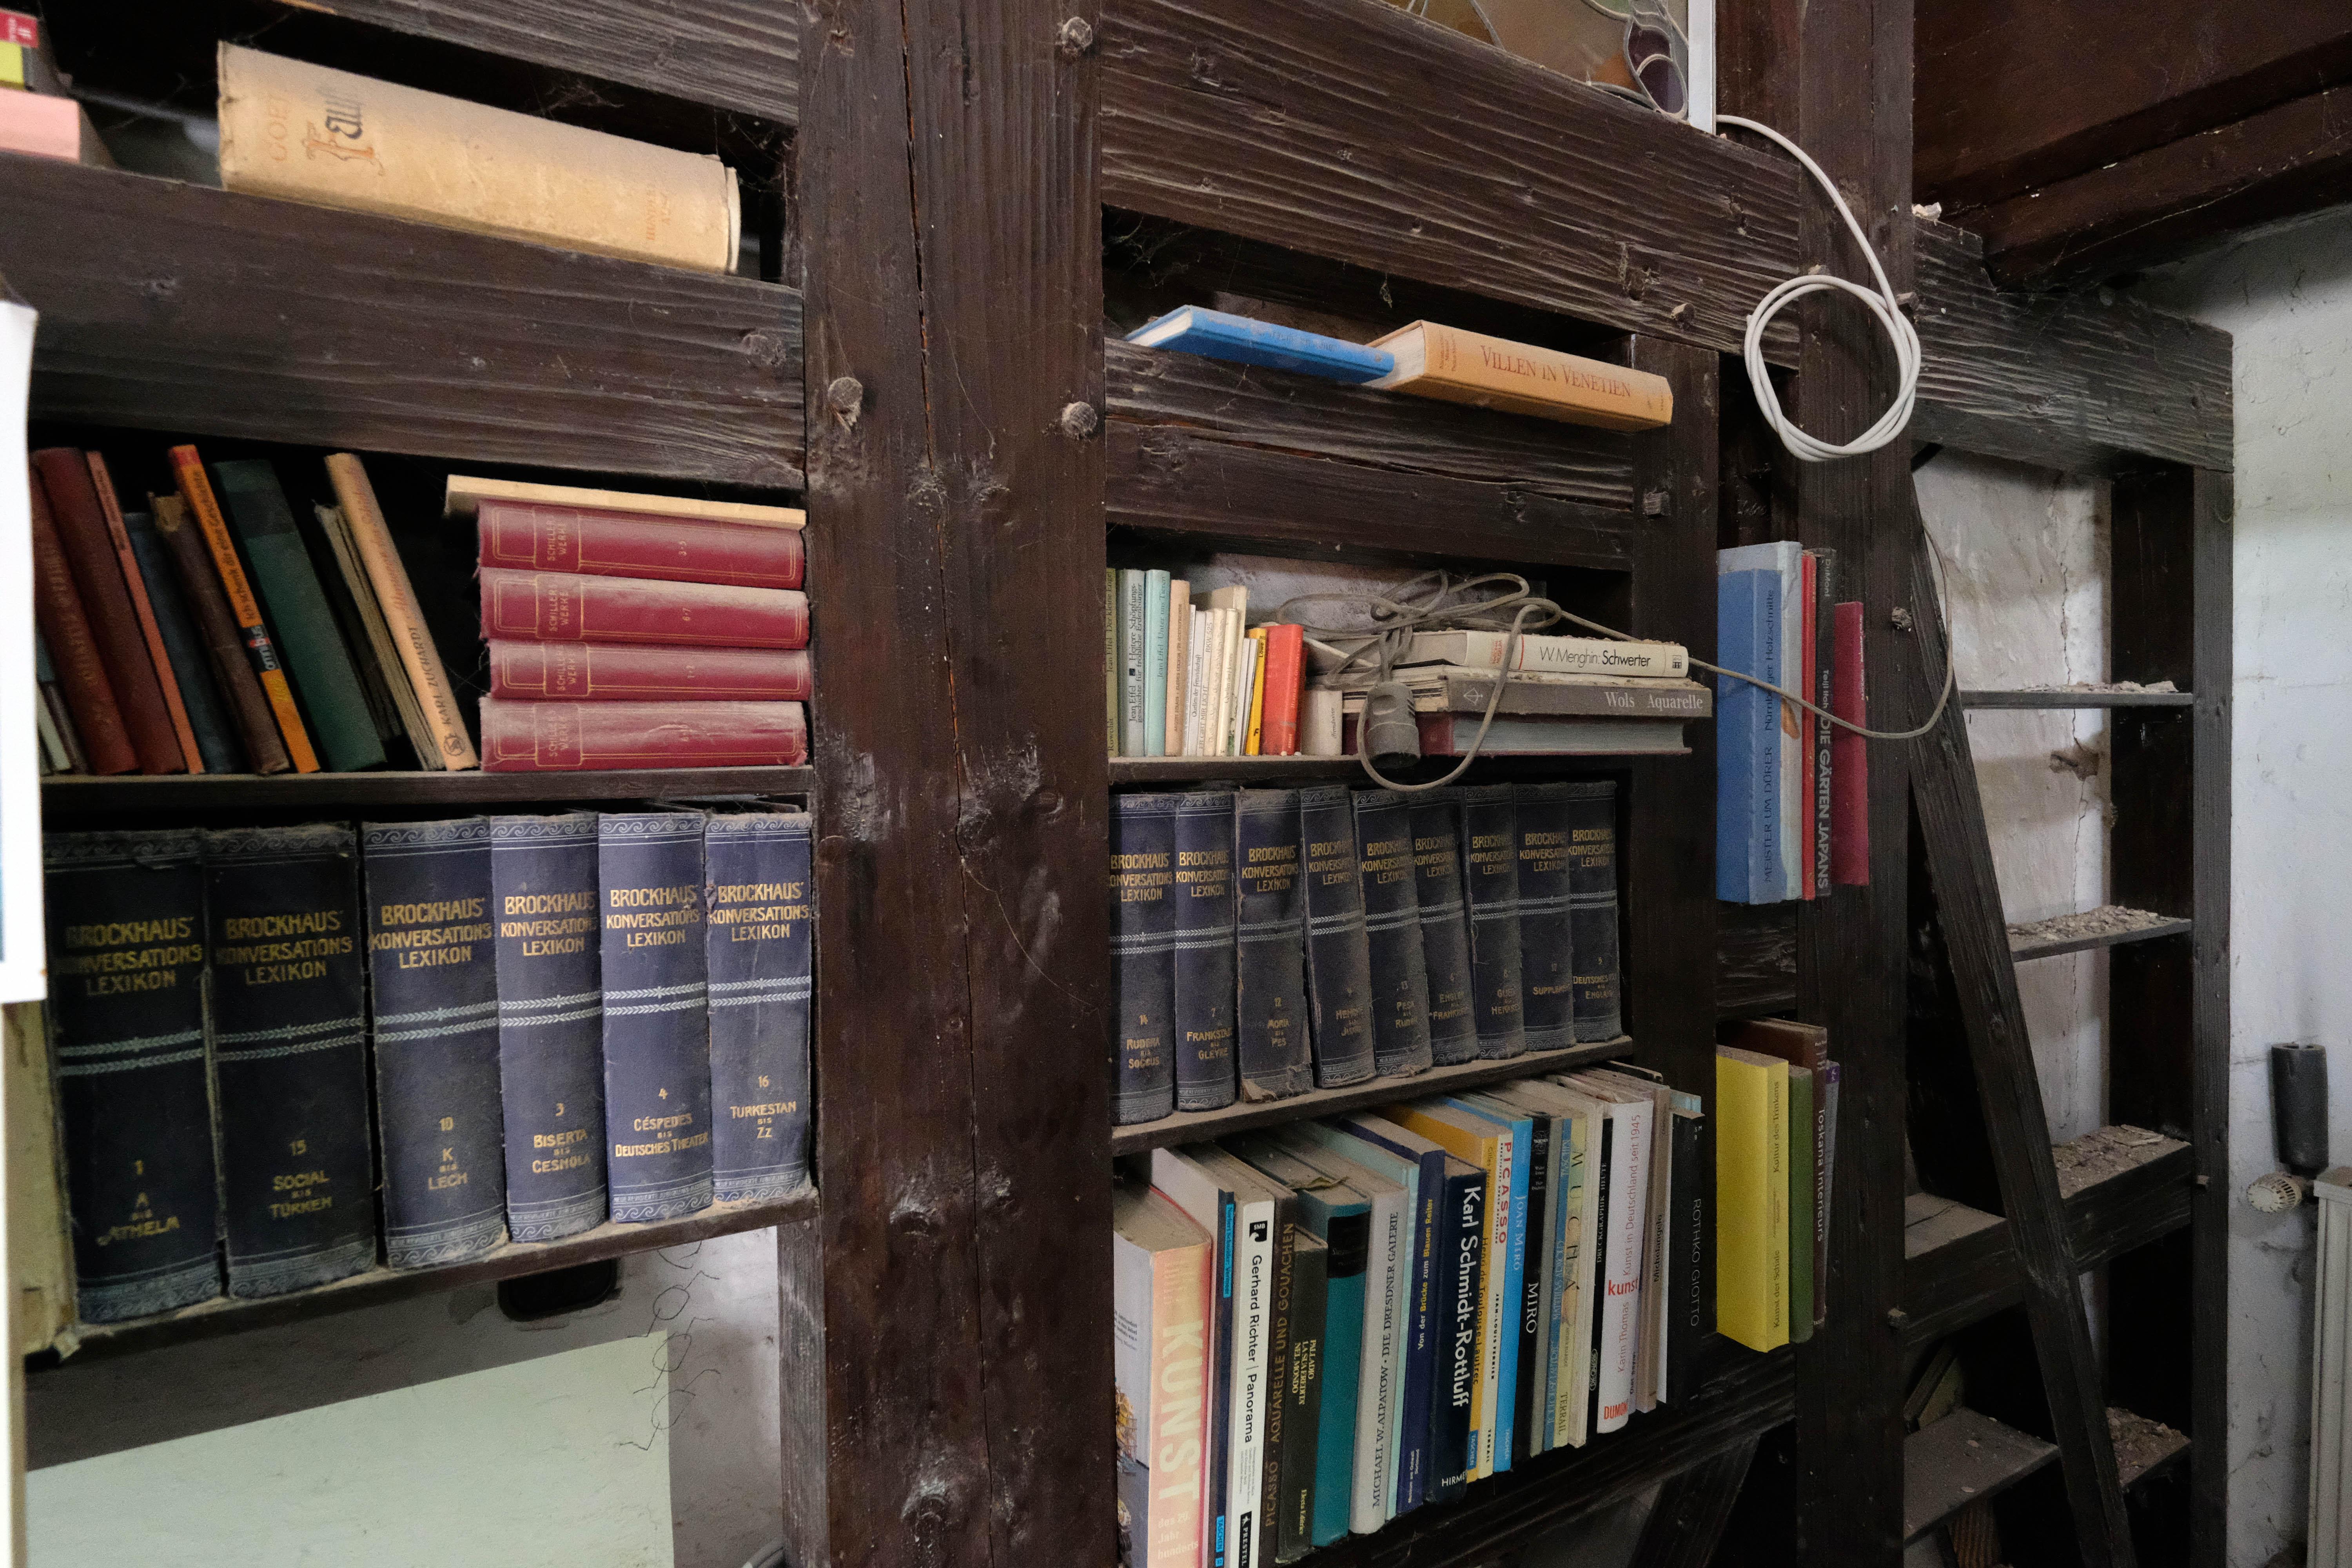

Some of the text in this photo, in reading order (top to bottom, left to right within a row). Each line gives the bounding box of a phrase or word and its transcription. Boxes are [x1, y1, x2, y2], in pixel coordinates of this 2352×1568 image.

[1480, 344, 1537, 379] VILLEN
[1560, 363, 1632, 398] VENETIEN
[559, 591, 569, 625] WERKE
[1129, 583, 1138, 630] Schöpfungs-
[249, 626, 276, 671] omnibus
[1539, 646, 1651, 672] W. Menghin: Schwerter
[1193, 654, 1201, 687] Freundschaft
[433, 694, 452, 726] KARL
[1129, 706, 1137, 723] Jean
[1604, 691, 1703, 712] Wols Aquarelle
[1764, 746, 1773, 882] MEISTER UM DÜRER
[1818, 716, 1832, 888] DIE GÄRTEN JAPANS
[1110, 870, 1173, 887] ONVERSATIONS
[1191, 883, 1225, 898] LEXIKON
[1256, 878, 1291, 893] LEXIKON
[1120, 886, 1163, 902] LEXIKON
[606, 908, 701, 930] KONVERSATIONS
[709, 905, 809, 925] KONVERSATIONS
[370, 923, 492, 951] KONVERSATIONS
[626, 929, 686, 948] LEXIKON
[731, 924, 790, 942] LEXIKON
[398, 945, 472, 970] LEXIKON
[522, 937, 586, 957] LEXIKON
[86, 969, 176, 996] LEXIKON
[245, 960, 327, 986] LEXIKON
[658, 1088, 668, 1100] 4
[759, 1076, 769, 1088] 16
[633, 1113, 693, 1132] CÉSPEDES
[730, 1101, 796, 1120] TURKESTAN
[439, 1116, 454, 1132] 10
[1632, 1114, 1641, 1140] 1945
[1817, 1106, 1826, 1167] Toskana
[289, 1139, 307, 1156] 15
[533, 1129, 588, 1149] BISERTA
[615, 1140, 671, 1158] DEUTSCHES
[442, 1147, 453, 1161] K
[1499, 1142, 1512, 1244] PICASSO
[1626, 1165, 1638, 1230] Deutschland
[1425, 1198, 1434, 1224] Reiter
[1514, 1195, 1525, 1229] JOAN
[1626, 1234, 1632, 1243] in
[1654, 1214, 1662, 1283] Michelangelo
[1623, 1246, 1631, 1276] Kunst
[1690, 1198, 1702, 1327] ROTHKO GIOTTO
[1250, 1255, 1262, 1310] Gerhard
[1607, 1278, 1639, 1296] kunst
[1452, 1186, 1481, 1407] Karl Schmidt-Rottluff
[1247, 1314, 1260, 1361] Richter
[1617, 1301, 1630, 1373] Karin Thomas
[1308, 1339, 1317, 1380] PALLADIO
[1373, 1212, 1399, 1509] MICHAEL DIE DRESDNER GALERIE
[1265, 1223, 1294, 1526] PICASSO AQUARELLE UND GOUACHEN
[1292, 1361, 1300, 1394] MONDO
[1158, 1319, 1205, 1500] KUNST
[1244, 1373, 1257, 1443] Panorama
[1557, 1392, 1568, 1435] TERRAIL
[1441, 1470, 1467, 1487] HIRME
